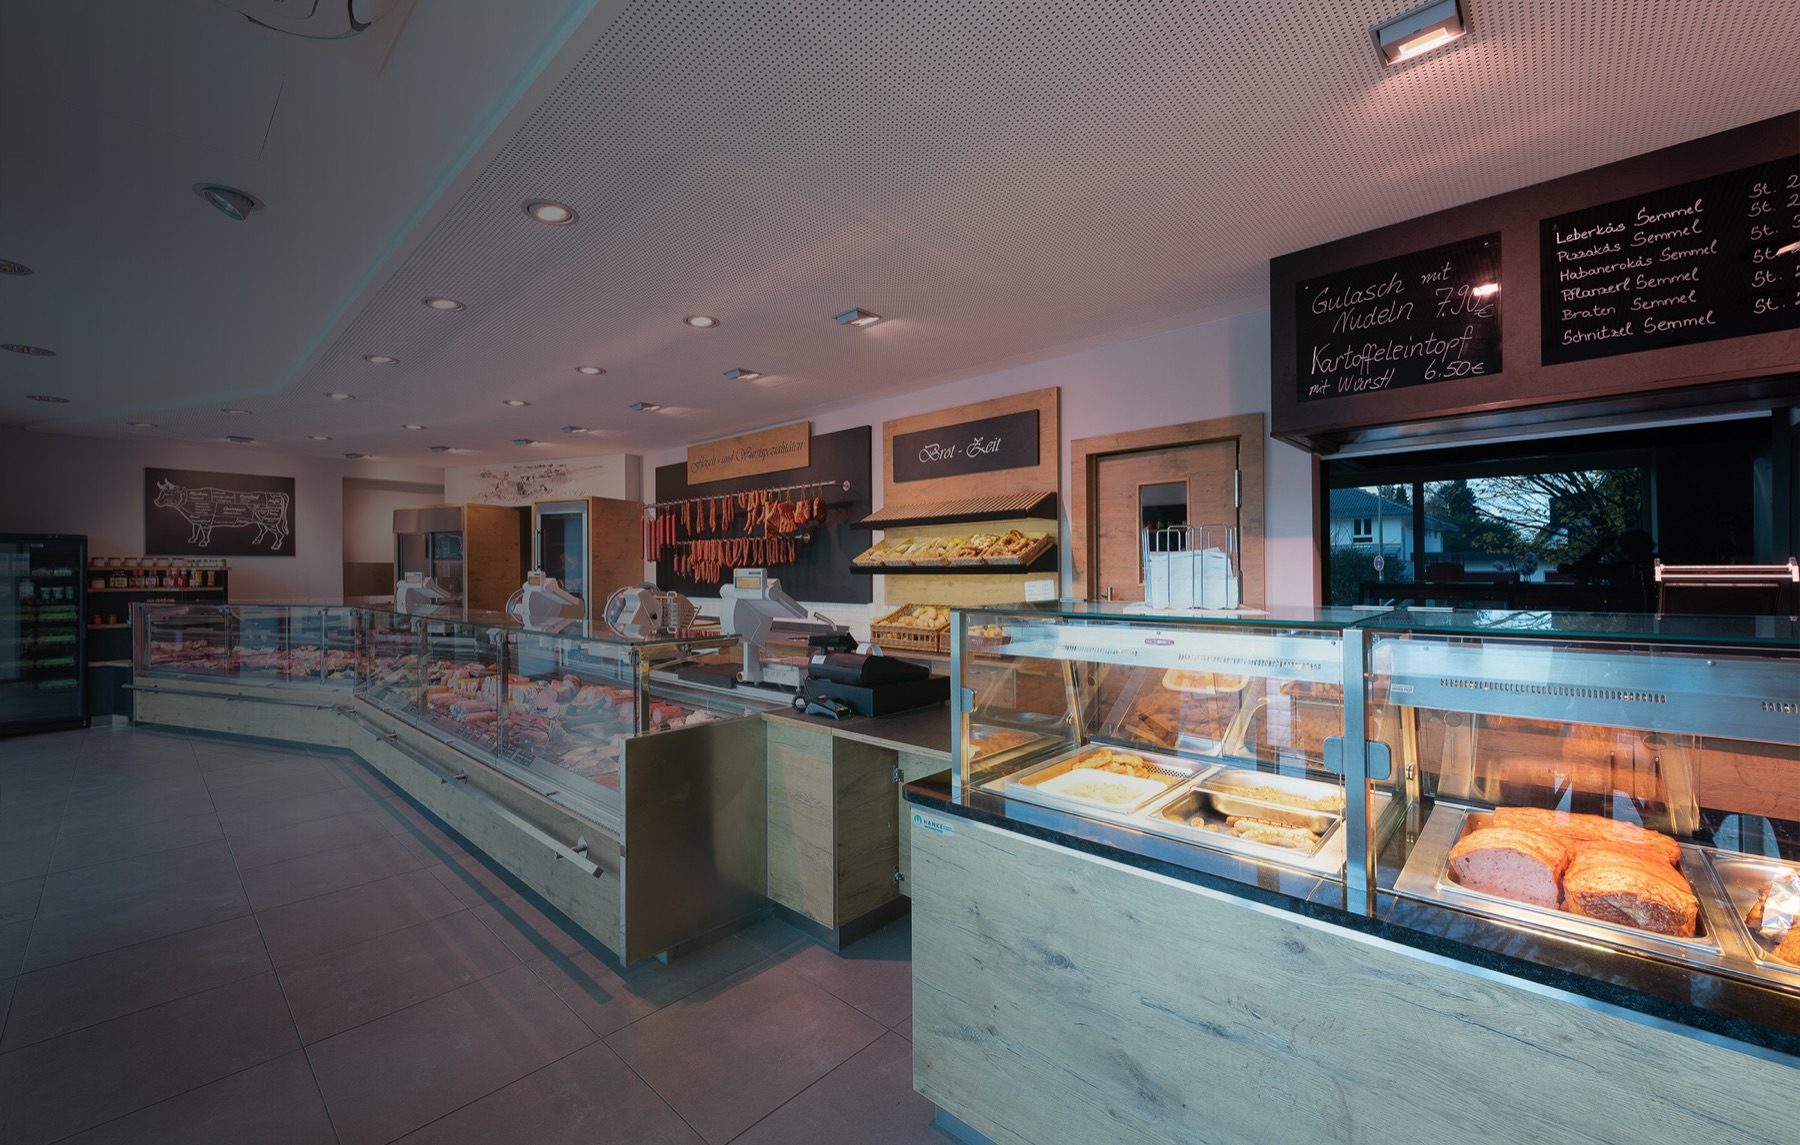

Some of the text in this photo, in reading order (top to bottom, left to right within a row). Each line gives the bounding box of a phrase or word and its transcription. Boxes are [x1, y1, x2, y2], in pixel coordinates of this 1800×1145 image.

[1630, 218, 1703, 247] Semmel
[1747, 200, 1776, 218] St.
[1634, 198, 1704, 227] Semmel
[1748, 182, 1777, 198] St.
[1659, 239, 1718, 262] Semmel
[1750, 224, 1779, 241] St.
[1312, 261, 1452, 314] Gulasch mit
[1560, 276, 1631, 302] Pflanzerl
[1635, 266, 1700, 290] Semmel
[1561, 304, 1616, 321] Braten
[1630, 288, 1697, 312] Semmel
[1751, 270, 1783, 288] St.
[1332, 300, 1414, 334] Nudeln
[1561, 321, 1634, 346] Schnitzel
[1644, 309, 1716, 334] Semmel
[1753, 297, 1786, 315] St.
[1311, 325, 1474, 376] Kartoffeleintopf
[1308, 378, 1332, 396] mit
[1424, 359, 1486, 381] 6.50€
[722, 450, 735, 464] und
[918, 443, 956, 463] Brot
[966, 436, 1002, 458] Zeit
[924, 820, 943, 830] HANKE
